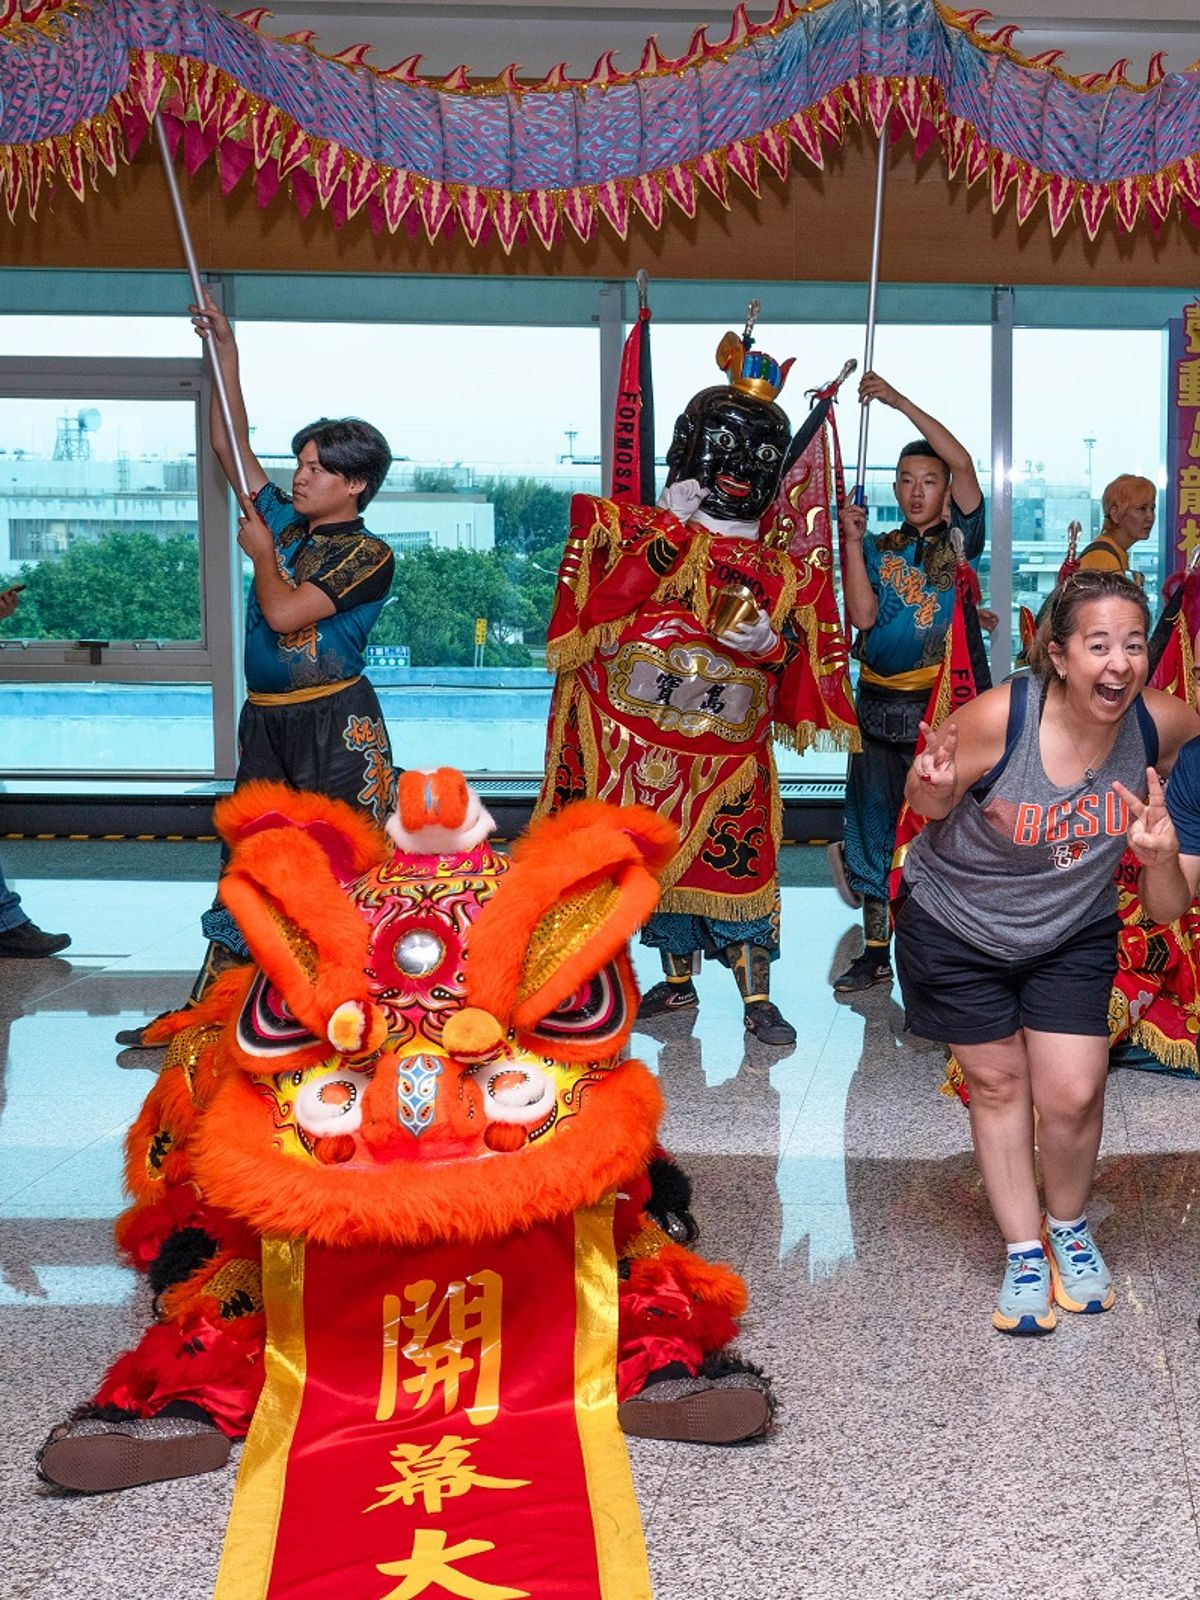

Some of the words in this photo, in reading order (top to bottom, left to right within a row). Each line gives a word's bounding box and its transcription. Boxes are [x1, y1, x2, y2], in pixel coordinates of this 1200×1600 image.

[615, 391, 638, 494] FORMOSA
[362, 1268, 532, 1600] 開幕大
